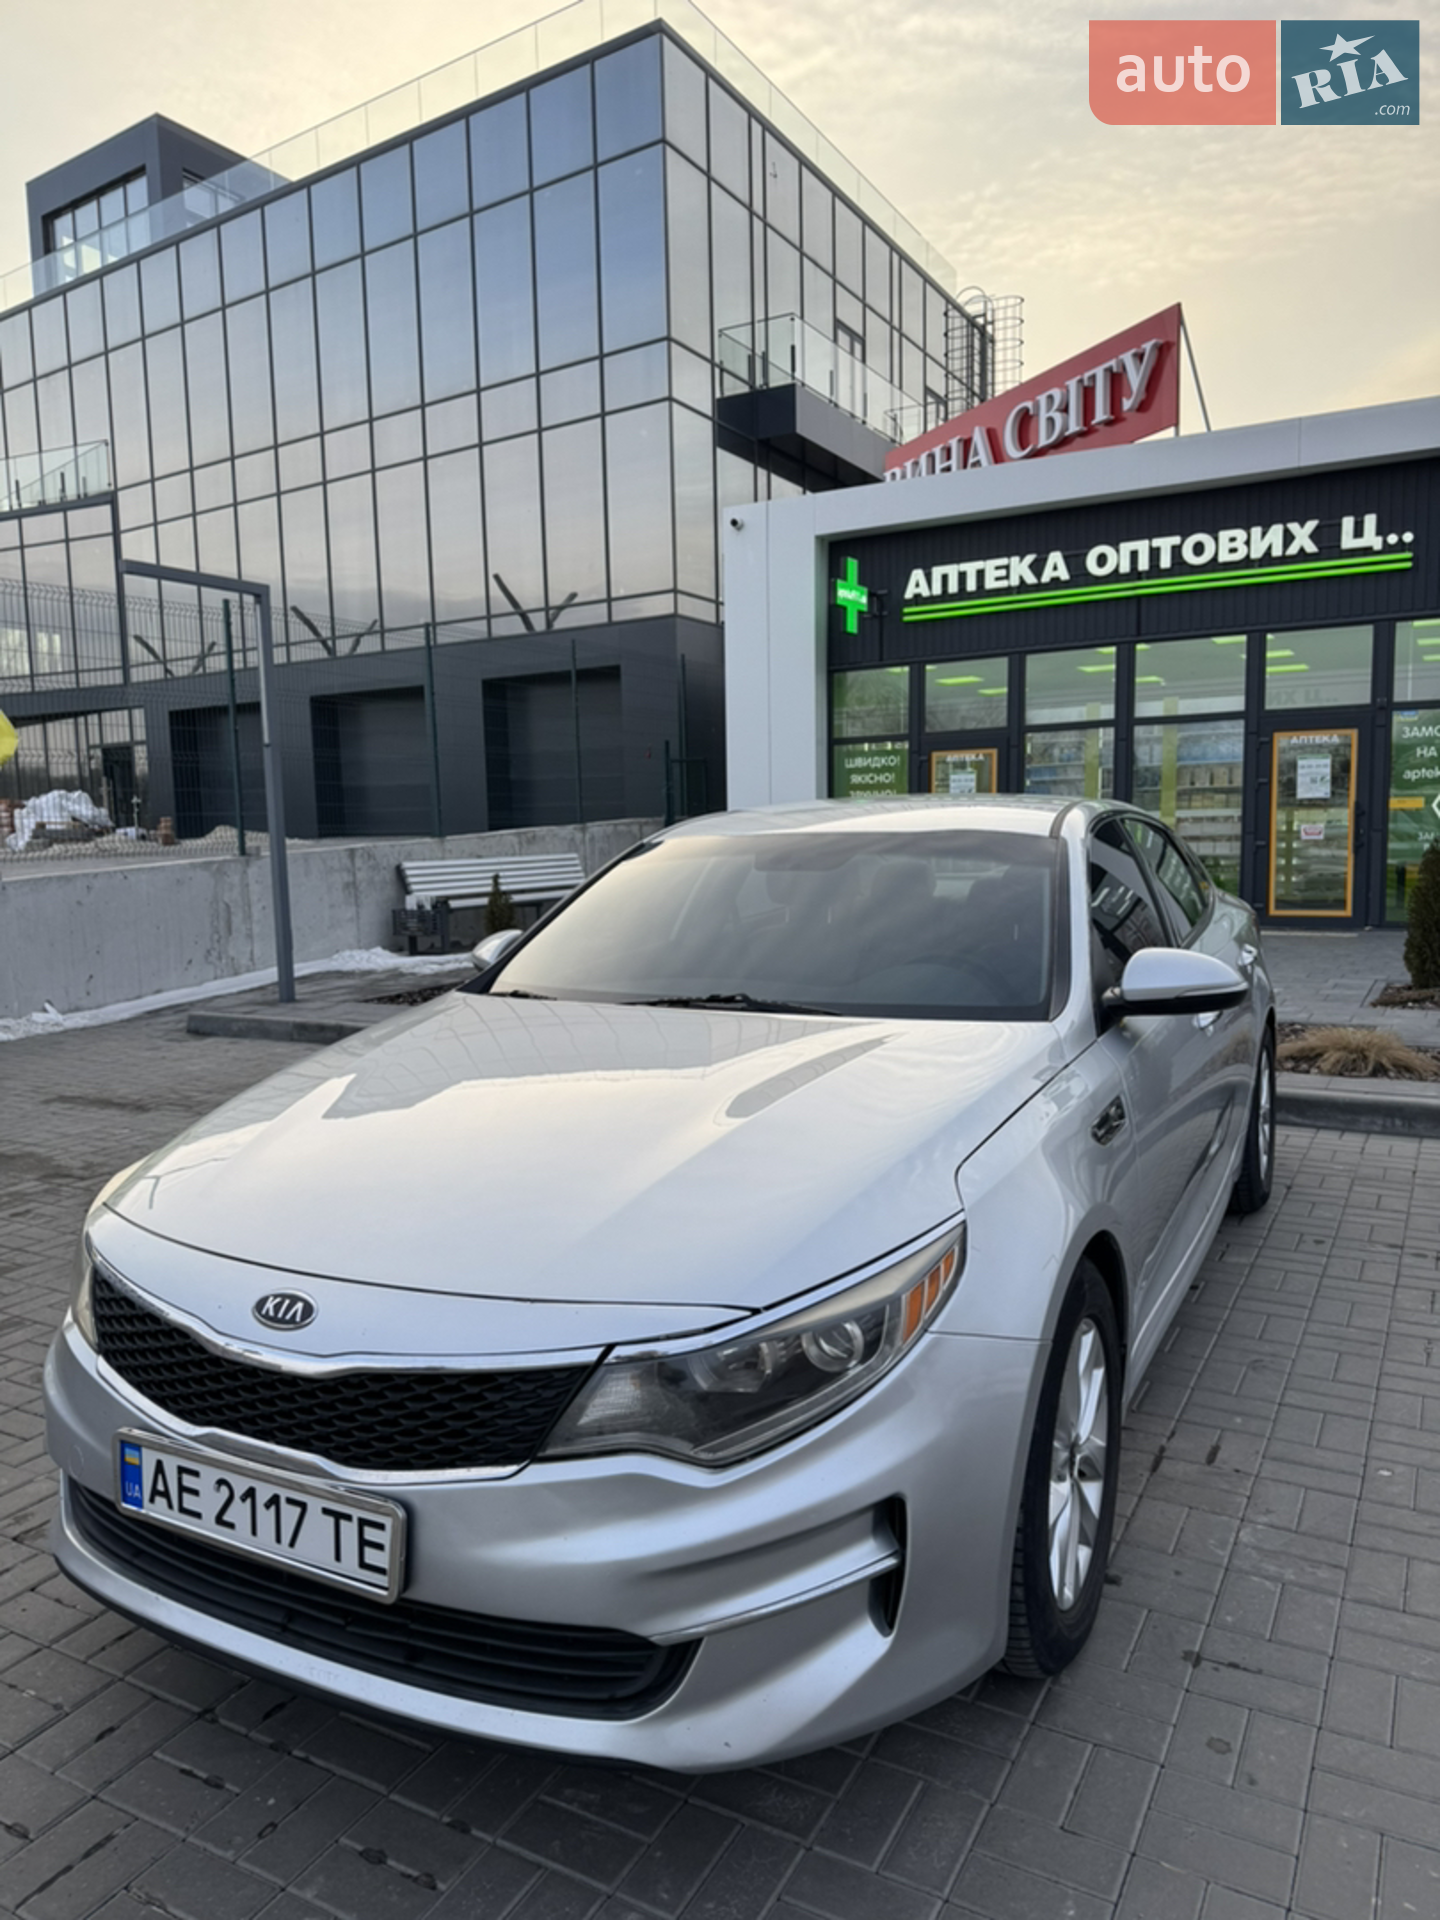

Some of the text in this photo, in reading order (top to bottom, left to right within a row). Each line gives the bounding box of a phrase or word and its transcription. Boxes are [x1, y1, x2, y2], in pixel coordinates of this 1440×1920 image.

[1003, 338, 1164, 460] СВІТУ
[904, 550, 1070, 600] АПТЕКА
[1085, 519, 1319, 577] ОПТОВИХ
[1290, 734, 1340, 745] АПТЕКА
[844, 755, 900, 769] ШВИДКО!
[1416, 746, 1438, 758] НА
[261, 1295, 304, 1323] KIA
[125, 1482, 142, 1500] UA
[148, 1458, 388, 1576] AE 2117 TE
